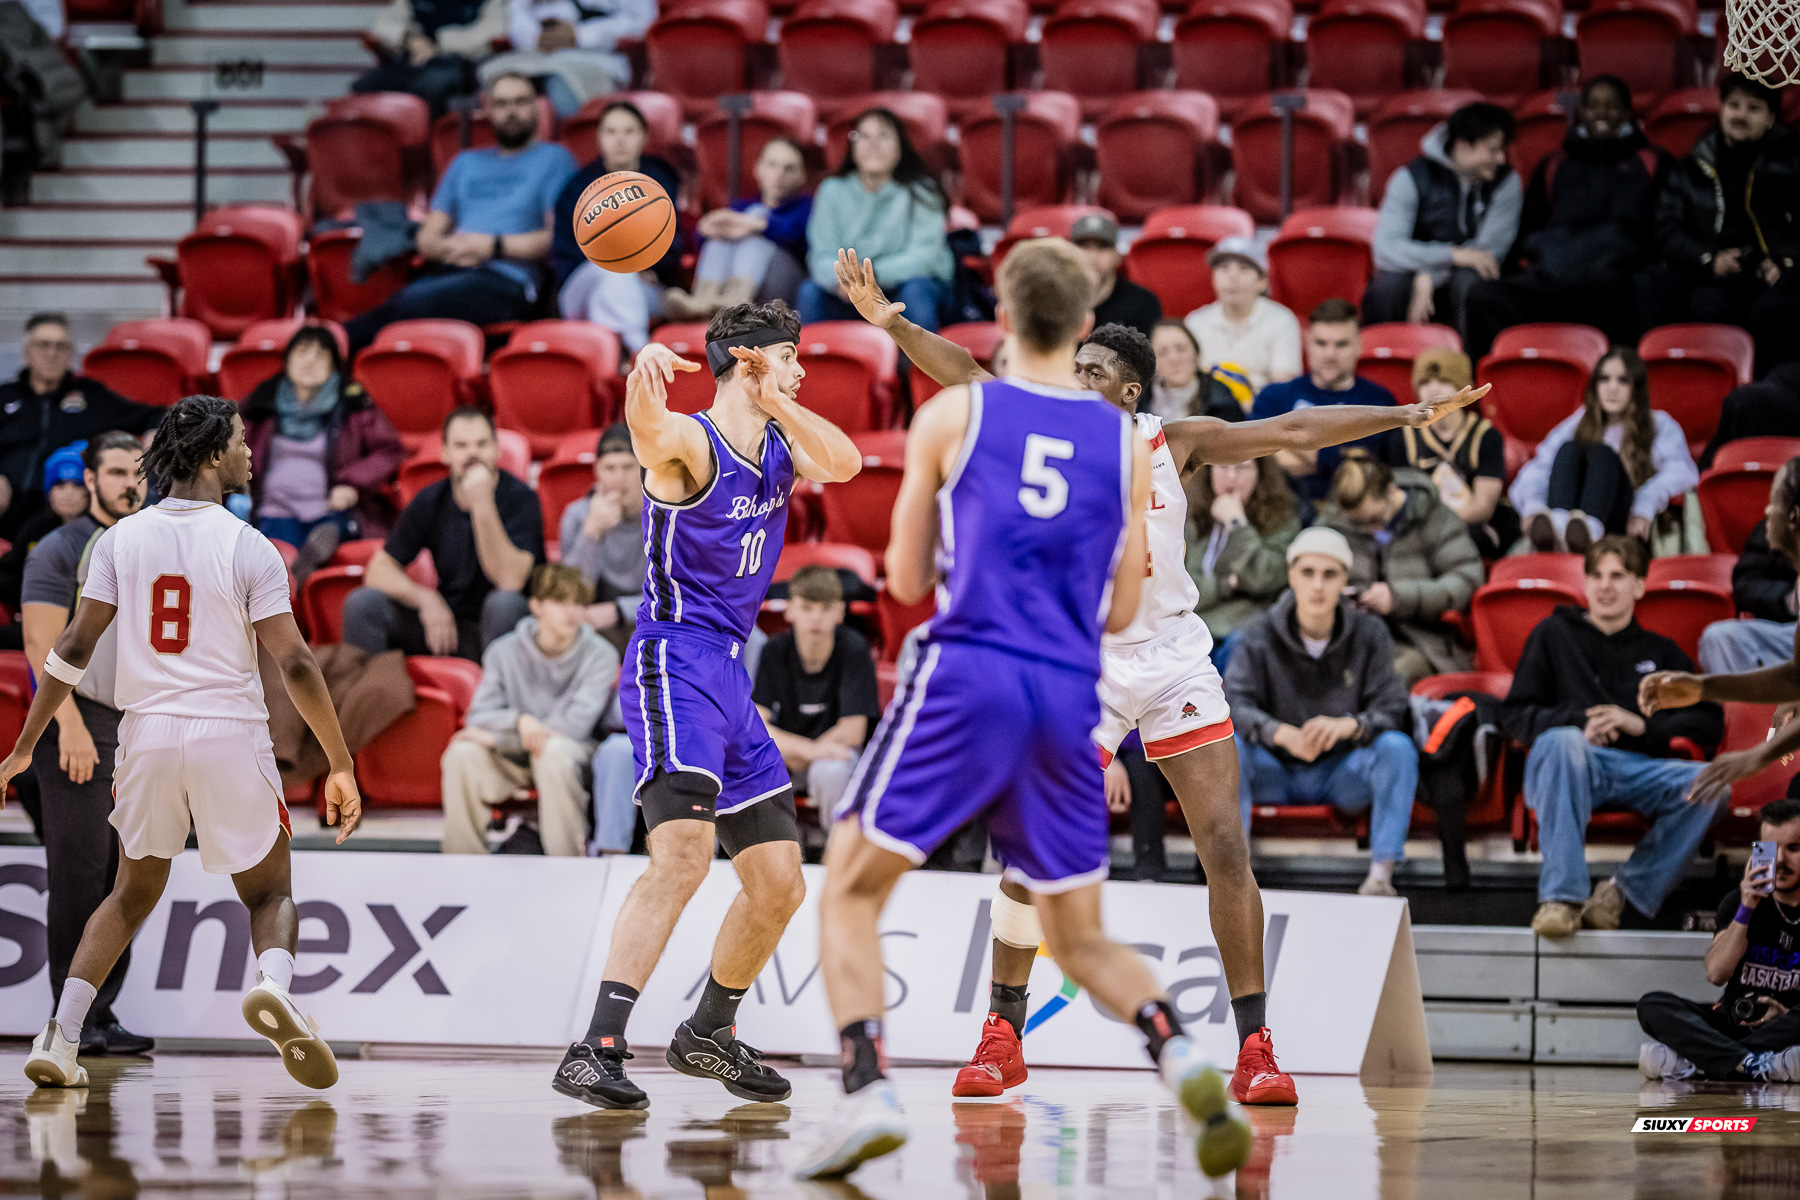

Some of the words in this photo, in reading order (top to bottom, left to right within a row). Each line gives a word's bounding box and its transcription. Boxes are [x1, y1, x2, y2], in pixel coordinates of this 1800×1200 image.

[583, 184, 648, 226] Wilson
[1018, 432, 1075, 520] 5
[735, 528, 767, 579] 10
[148, 573, 193, 656] 8
[0, 864, 468, 996] Snex
[562, 1060, 600, 1086] AIR
[685, 1052, 742, 1081] AIR
